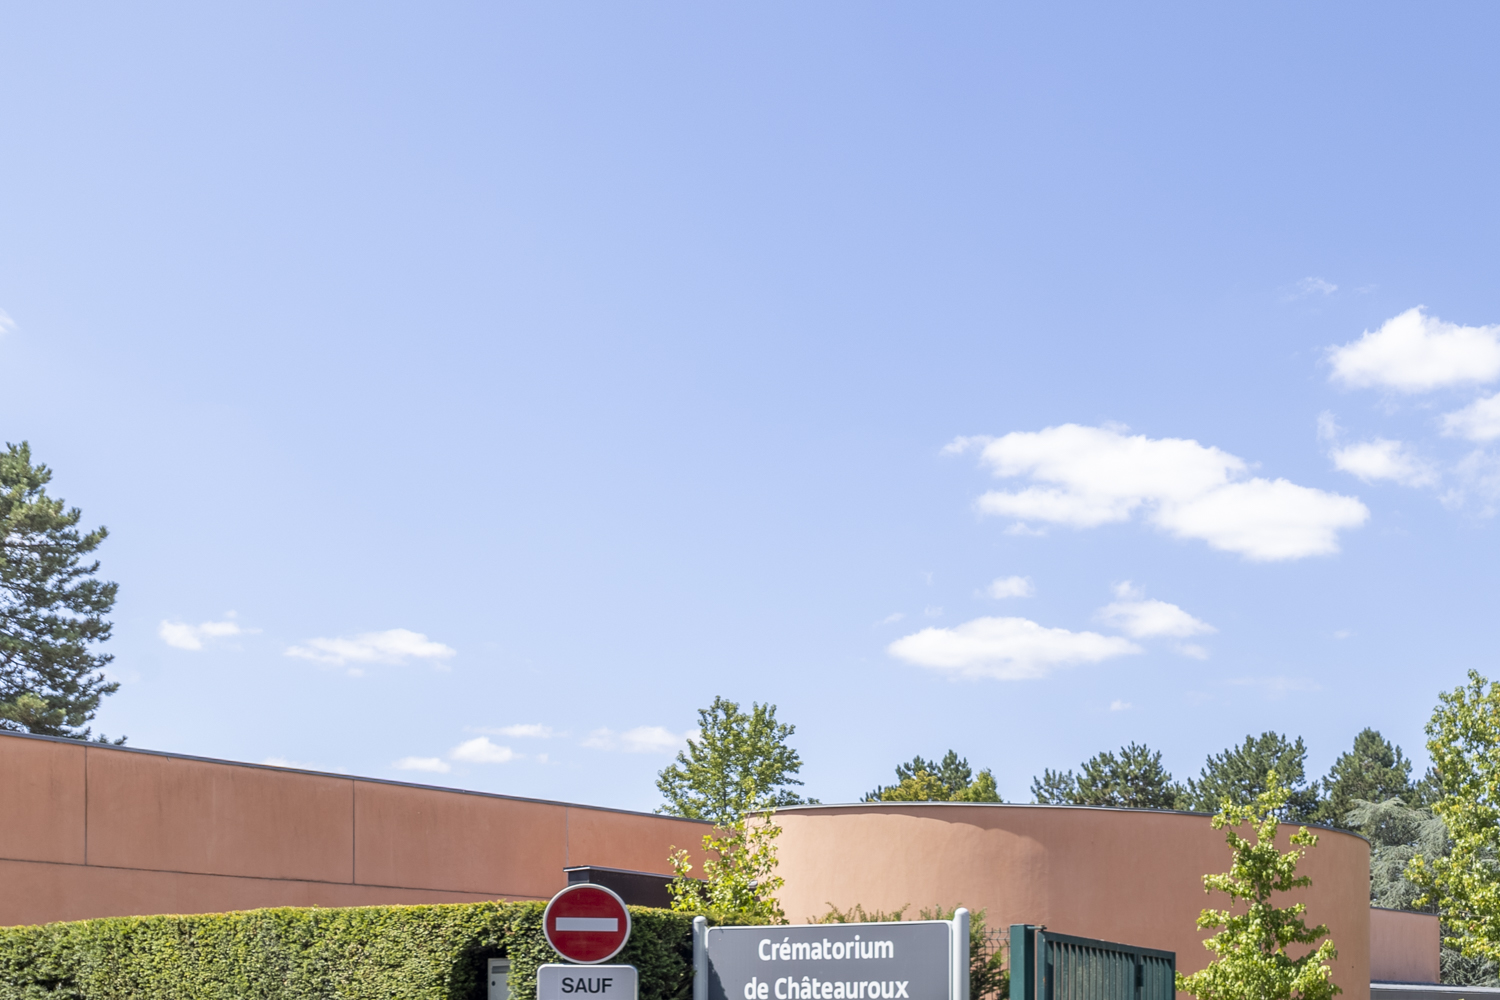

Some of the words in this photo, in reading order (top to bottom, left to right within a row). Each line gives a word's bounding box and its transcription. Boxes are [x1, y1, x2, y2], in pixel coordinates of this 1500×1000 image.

[758, 934, 894, 961] Crématorium
[561, 977, 613, 993] SAUF
[743, 976, 769, 1000] de
[774, 975, 909, 1000] Châteauroux
